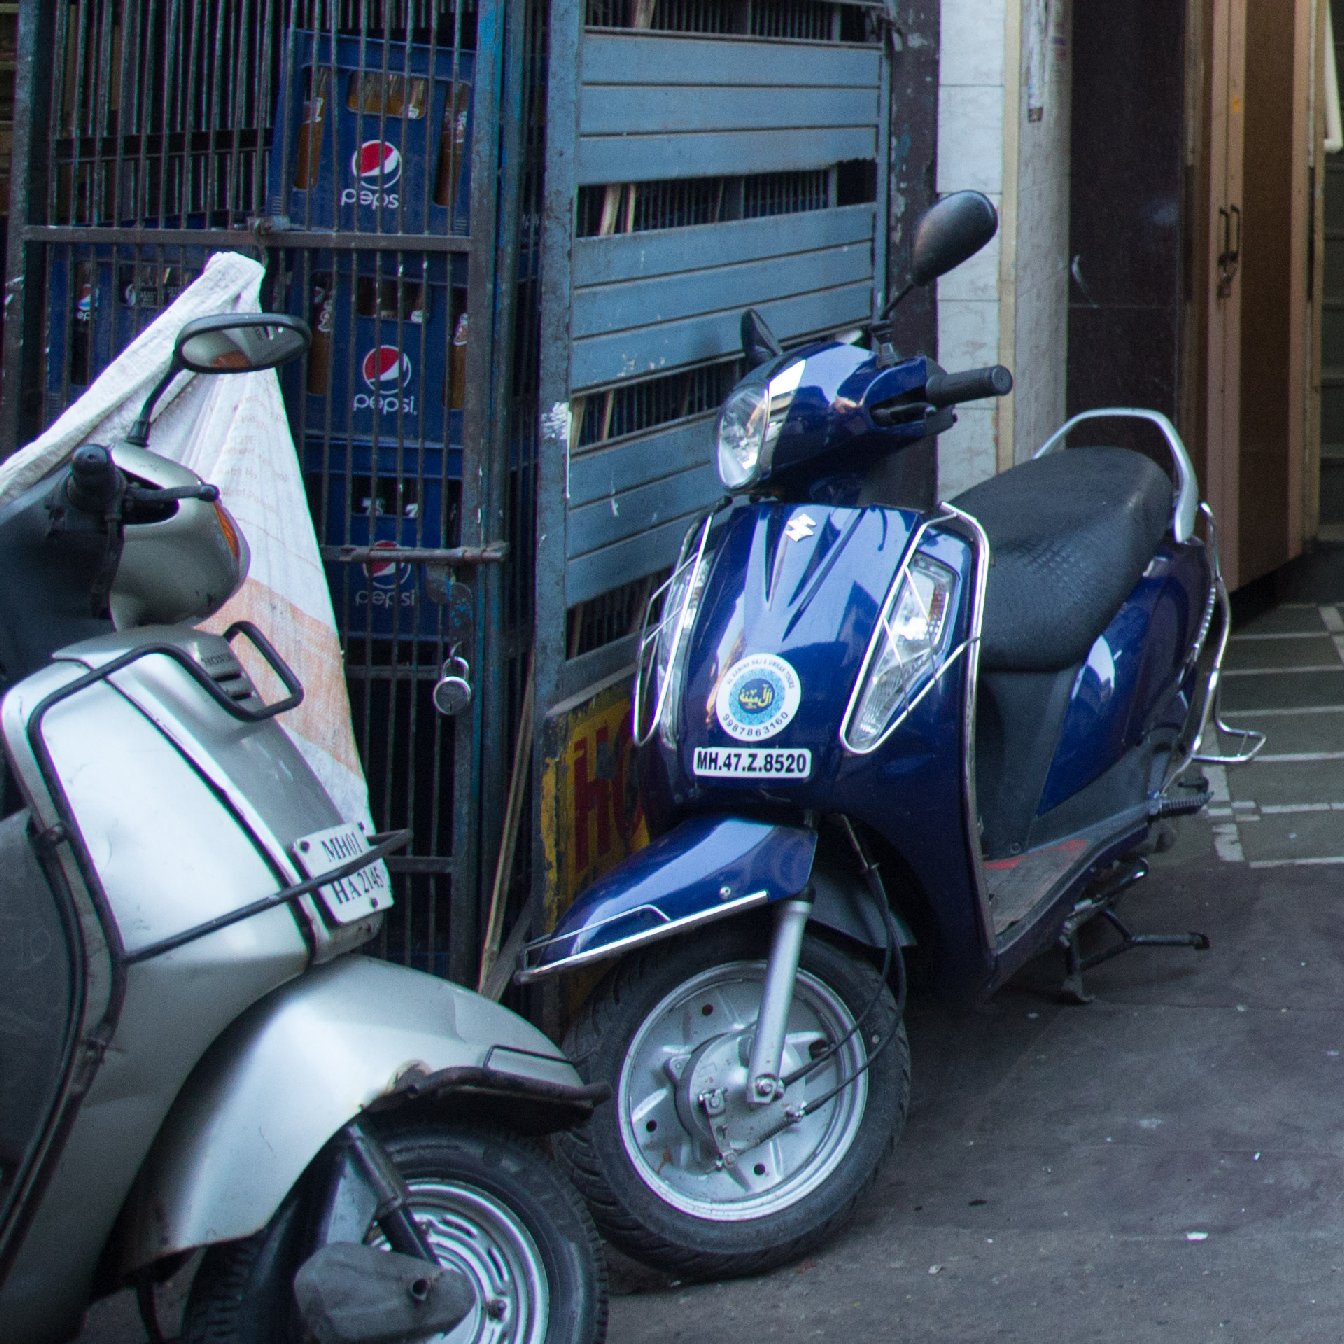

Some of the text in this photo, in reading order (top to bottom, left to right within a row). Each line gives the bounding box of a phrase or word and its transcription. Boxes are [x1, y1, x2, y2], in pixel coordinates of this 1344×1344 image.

[340, 188, 401, 211] peps
[697, 751, 807, 774] MH.47.Z.8520
[321, 831, 363, 862] MH01
